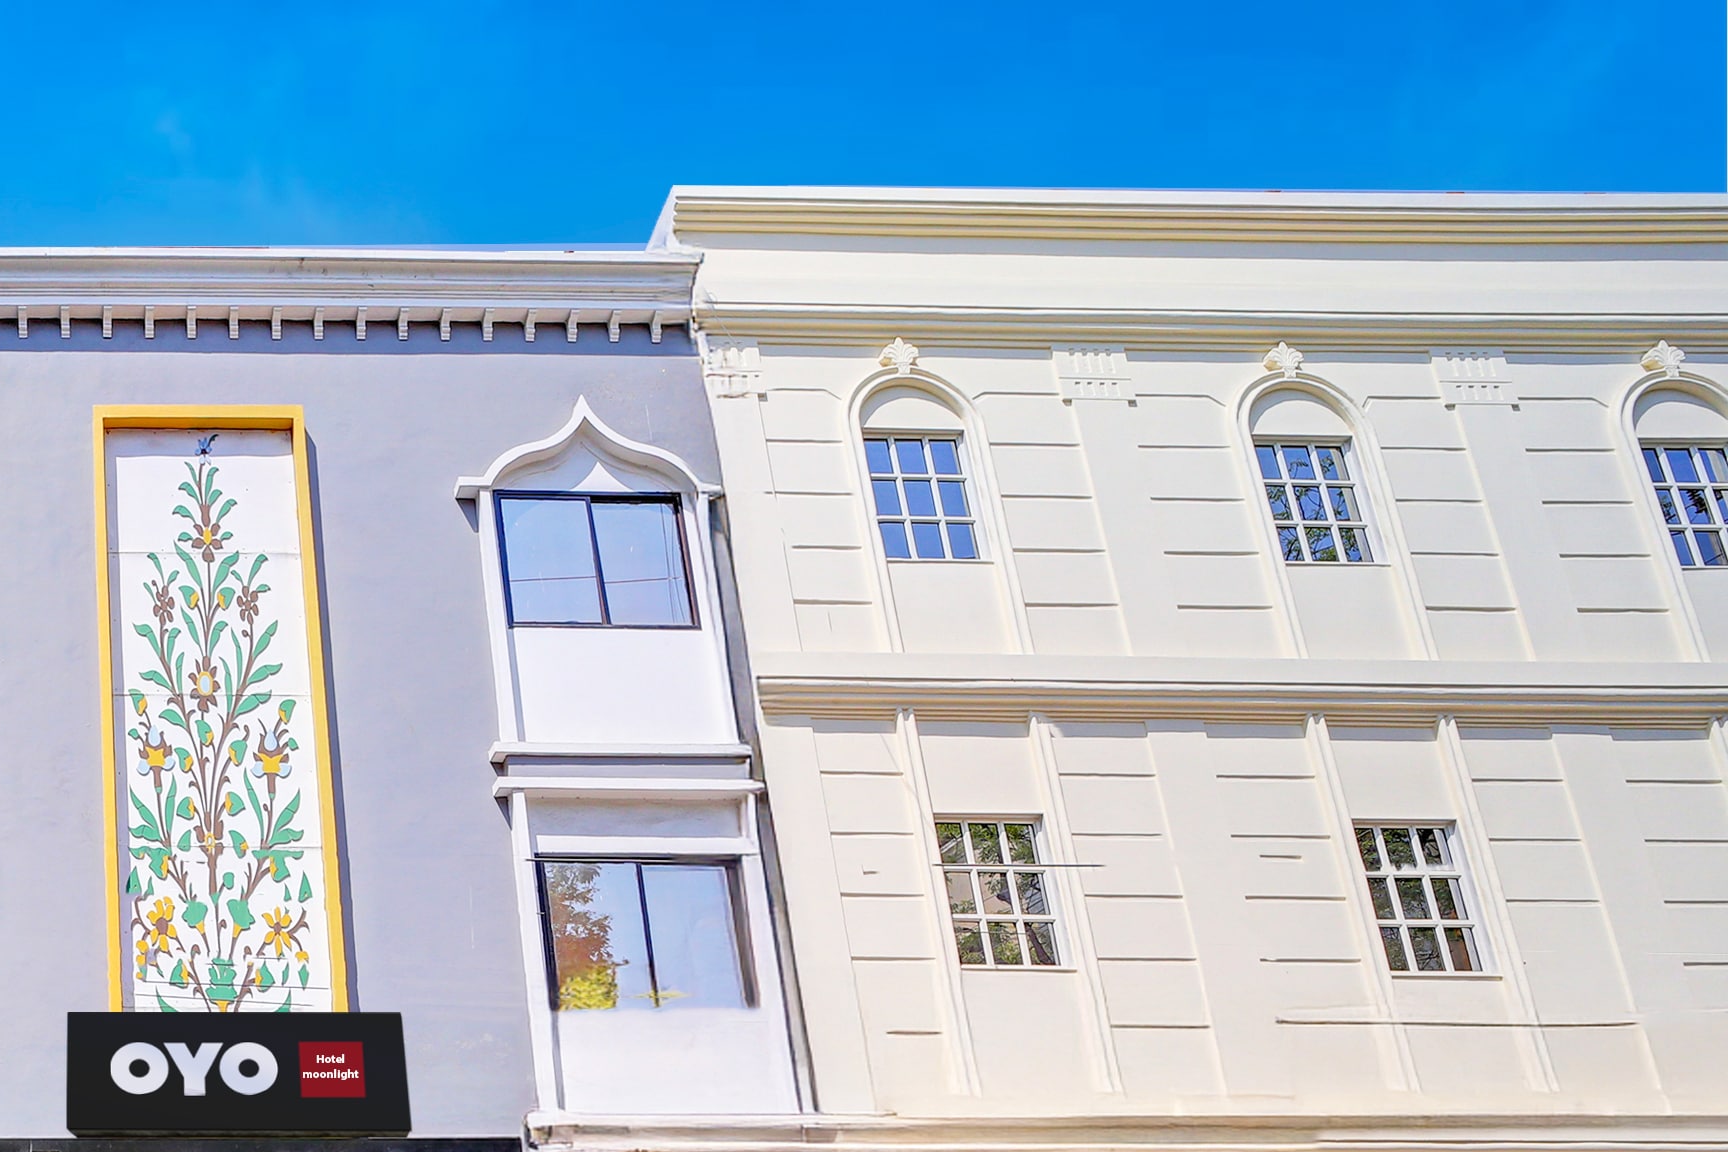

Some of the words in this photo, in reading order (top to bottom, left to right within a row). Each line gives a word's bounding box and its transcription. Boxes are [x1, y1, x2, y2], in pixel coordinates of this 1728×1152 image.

[316, 1053, 345, 1064] Hotel
[110, 1041, 278, 1097] OYO
[302, 1068, 359, 1081] moonlight
